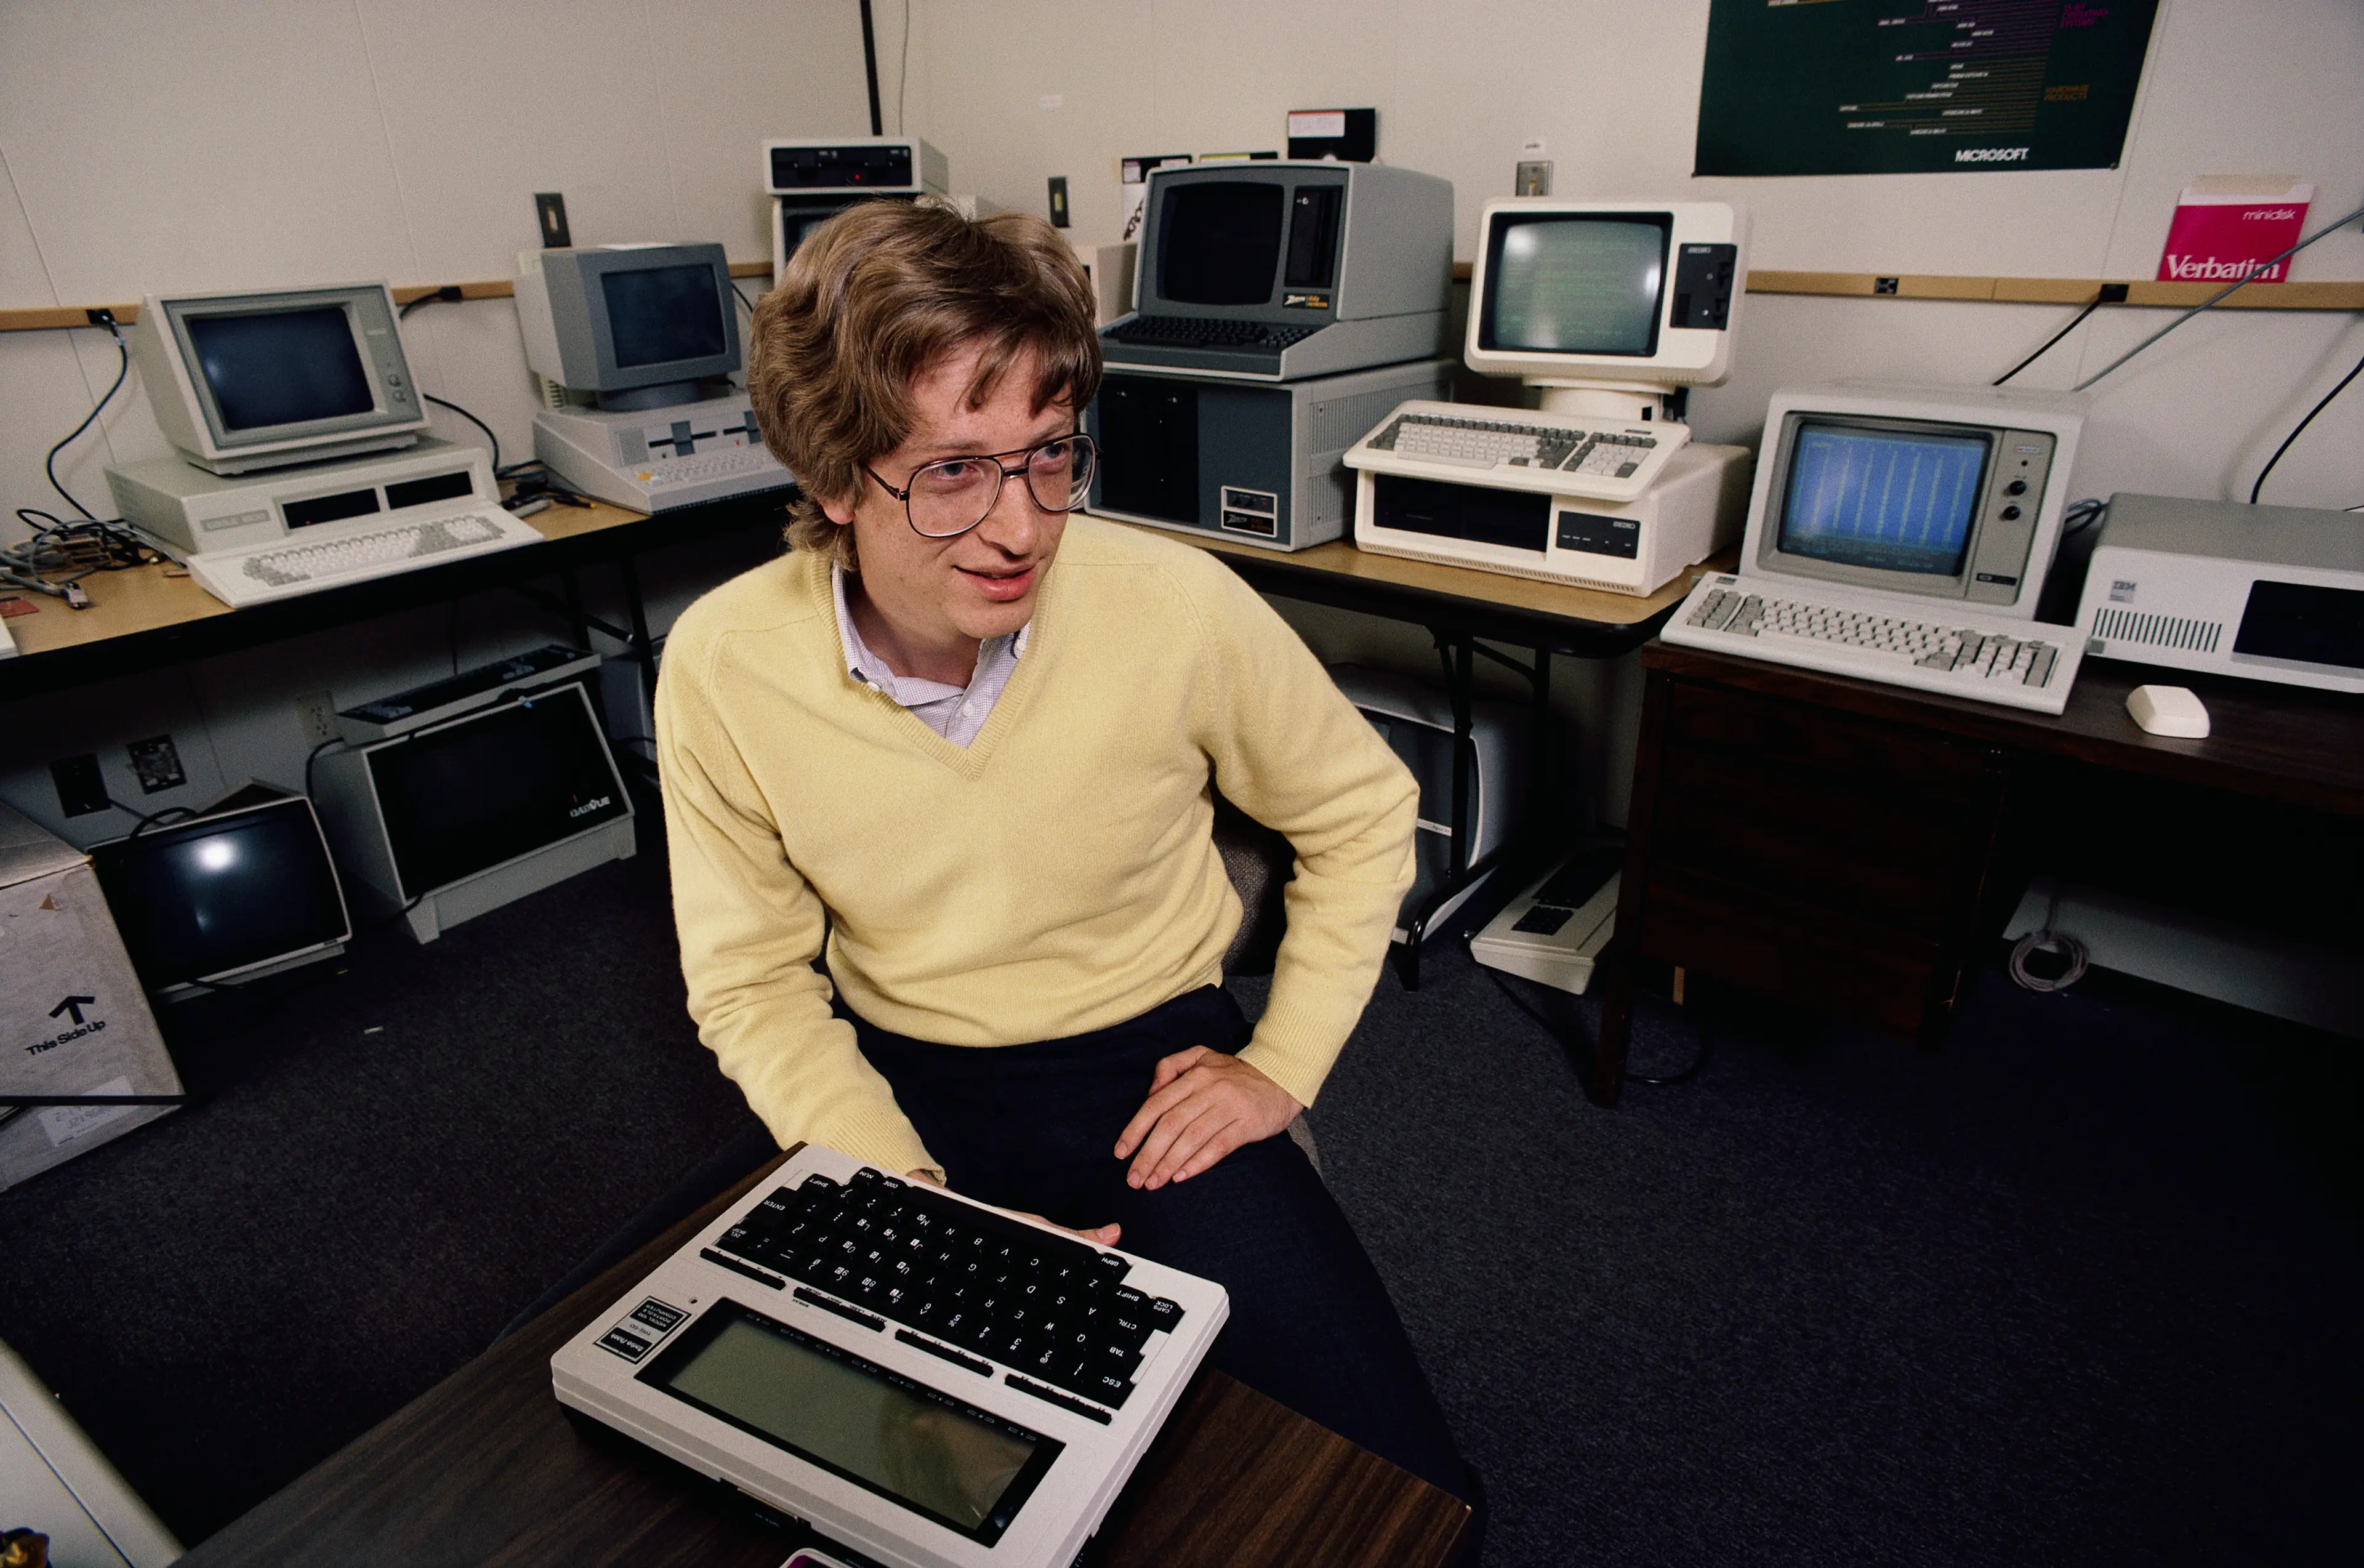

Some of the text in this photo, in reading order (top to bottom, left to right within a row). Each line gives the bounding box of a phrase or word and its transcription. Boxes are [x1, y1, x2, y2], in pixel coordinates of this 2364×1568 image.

[1955, 148, 2030, 162] MICROSOFT
[2242, 209, 2296, 220] minidisk
[25, 1021, 105, 1055] This Side Up
[858, 1170, 874, 1180] NUM
[809, 1178, 829, 1188] SHIFT
[883, 1180, 899, 1189] CODE
[764, 1200, 786, 1211] ENTER
[1101, 1257, 1119, 1266] GRPH
[1117, 1290, 1140, 1302] SHIFT
[1153, 1306, 1170, 1314] CAPS
[1155, 1300, 1173, 1310] LOCK
[643, 1308, 671, 1323] PORTABLE
[646, 1305, 677, 1319] COMPUTER
[1015, 1311, 1024, 1319] E
[649, 1316, 667, 1327] MODEL
[1119, 1318, 1137, 1330] CTRL
[1077, 1334, 1085, 1342] Q
[627, 1341, 644, 1352] Radio
[1109, 1346, 1124, 1357] TAB
[1102, 1377, 1122, 1388] ESC
